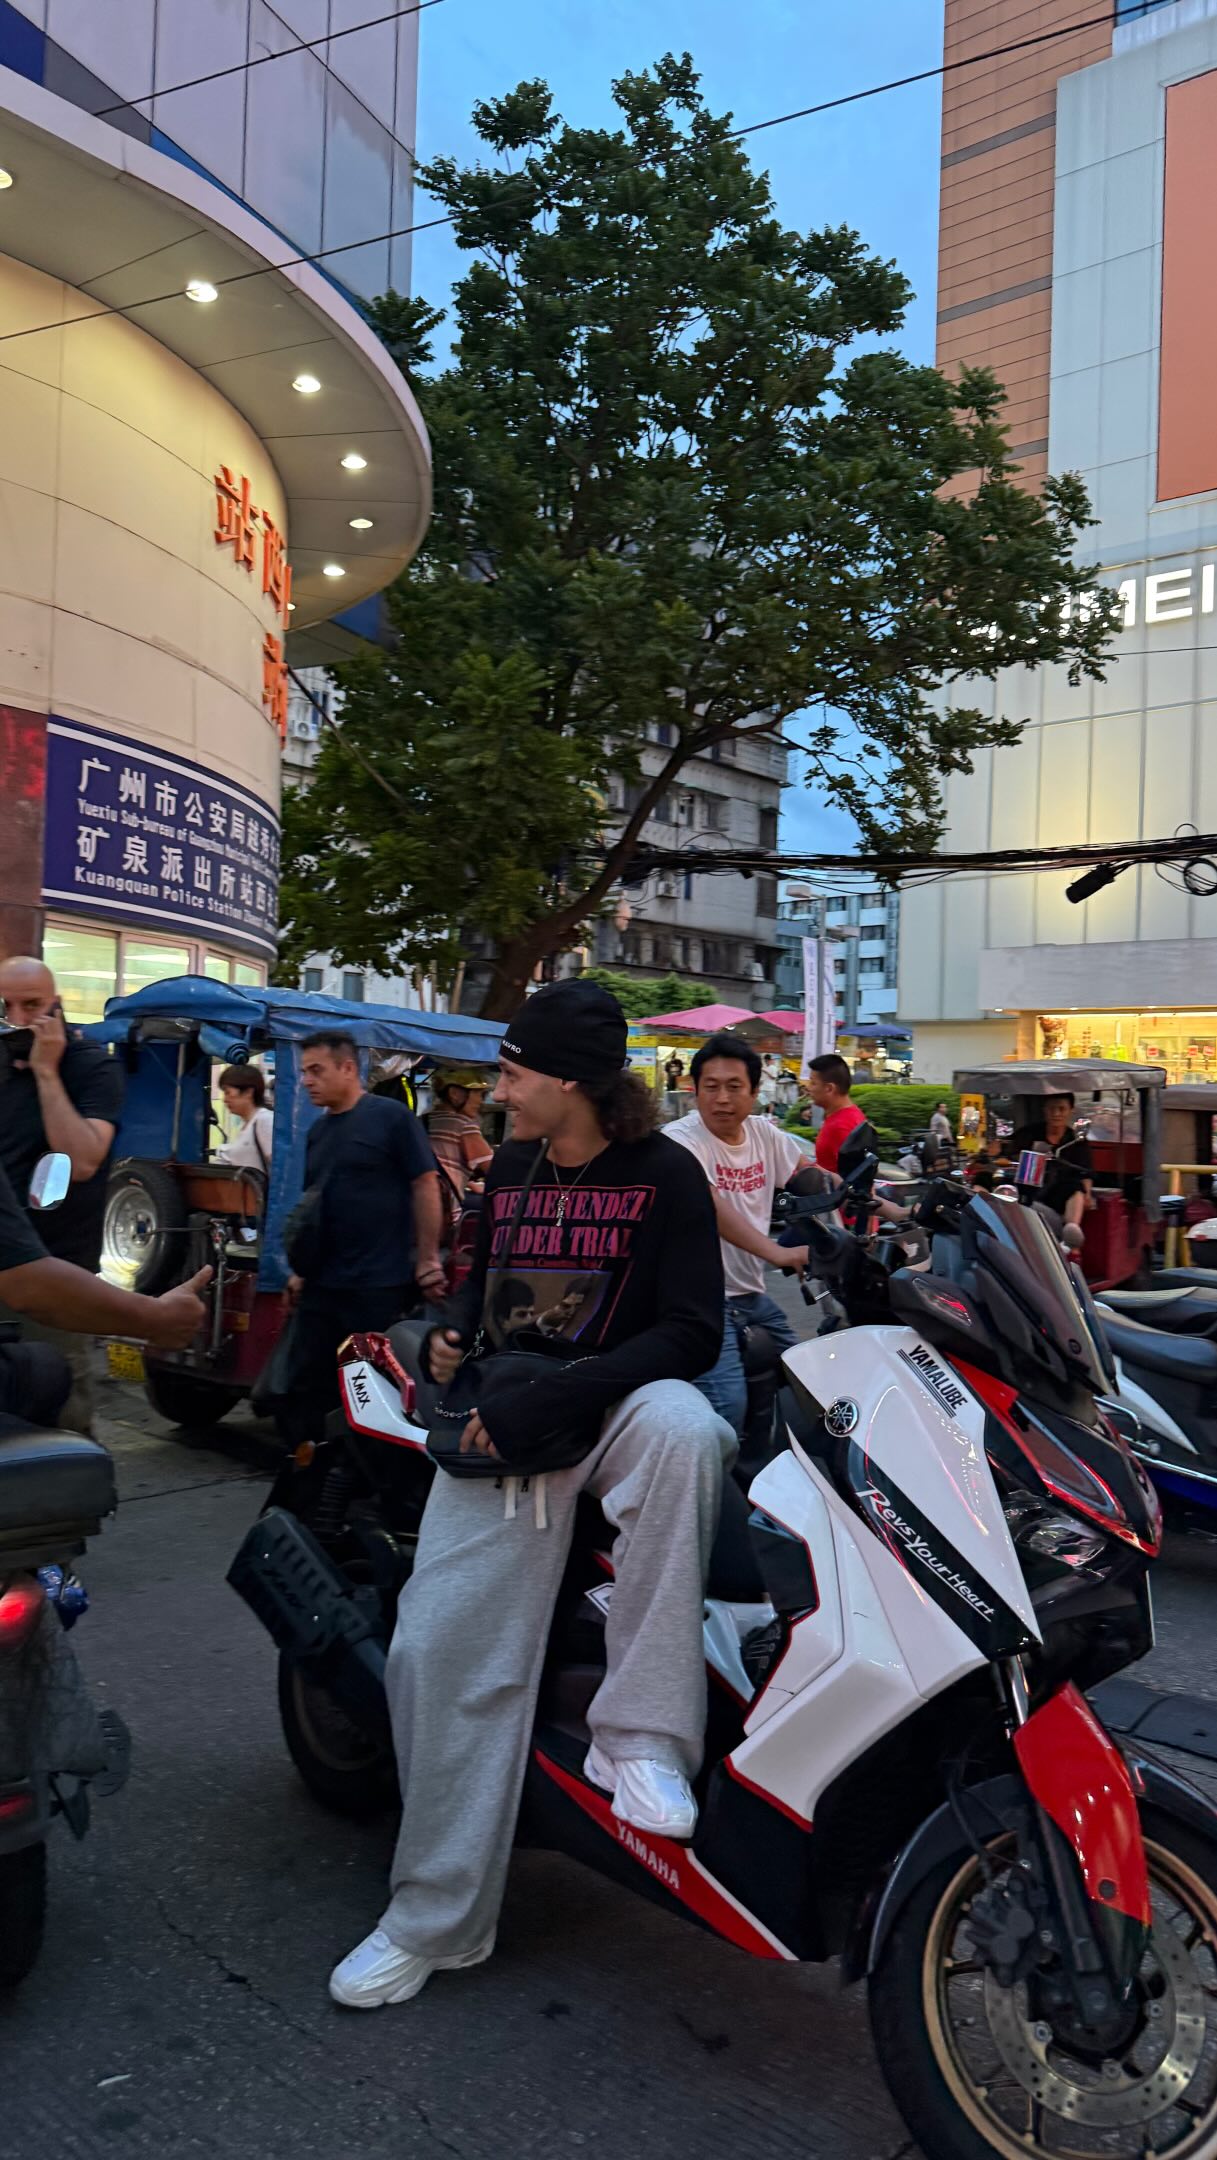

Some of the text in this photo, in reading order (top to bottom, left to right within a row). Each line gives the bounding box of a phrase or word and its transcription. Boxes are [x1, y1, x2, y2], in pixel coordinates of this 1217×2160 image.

[77, 798, 118, 822] Yuexiu
[121, 810, 176, 838] Sub-bureau
[177, 828, 188, 842] of
[75, 865, 159, 897] Kuangquan
[163, 885, 204, 909] Police
[207, 897, 243, 920] Station
[570, 1226, 632, 1258] TRIAL
[351, 1367, 371, 1410] XMAX
[908, 1344, 968, 1410] YAMALUBE
[616, 1819, 681, 1890] YAMAHA
